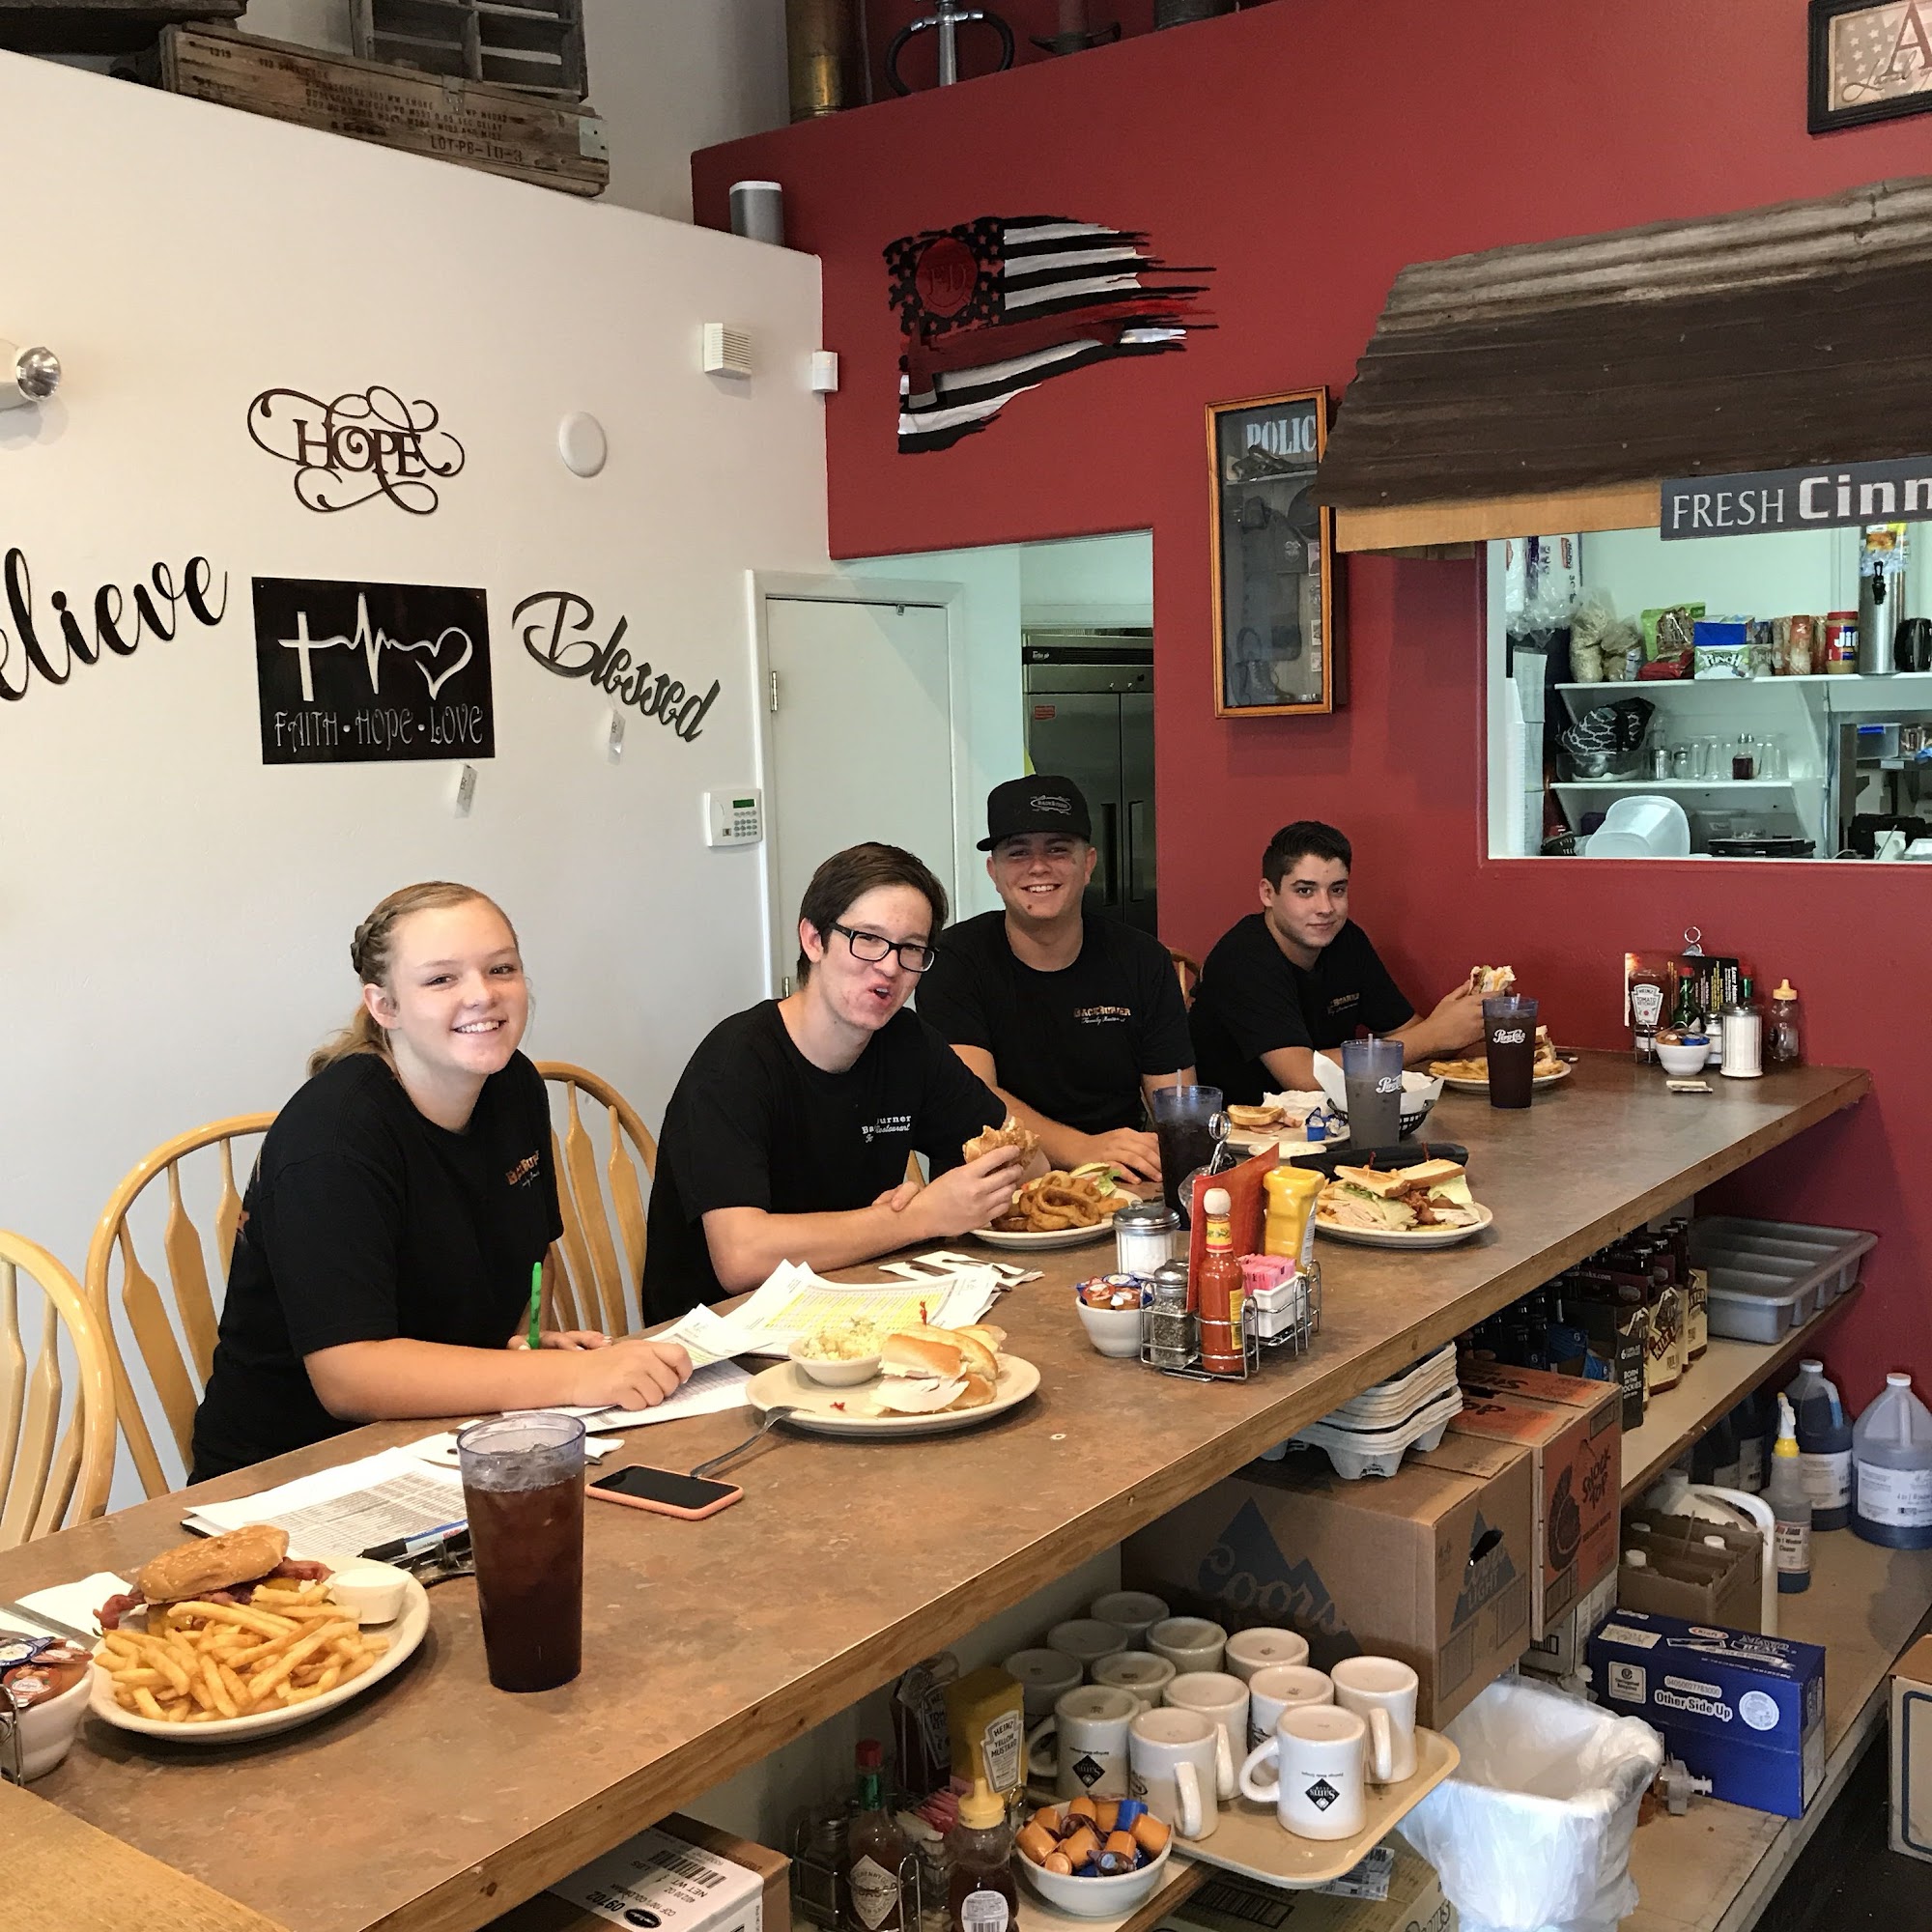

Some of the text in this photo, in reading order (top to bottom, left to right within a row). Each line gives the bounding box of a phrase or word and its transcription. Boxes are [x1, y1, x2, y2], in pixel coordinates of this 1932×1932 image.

[405, 96, 434, 110] SMOKE
[476, 120, 503, 132] DELAY
[1246, 414, 1316, 456] POLIC
[1672, 488, 1784, 529] FRESH
[512, 590, 721, 742] Blessed
[274, 705, 484, 753] FAITH HOPE LOVE
[1621, 1380, 1642, 1393] OCKIES
[1197, 1542, 1350, 1635] Coors
[1656, 1691, 1686, 1708] Other
[1689, 1698, 1713, 1714] Side
[1716, 1703, 1731, 1719] Up
[993, 1720, 1014, 1737] HEINZ
[990, 1738, 1018, 1758] MUSTARD
[994, 1732, 1014, 1748] YELLOW
[629, 1860, 651, 1870] LBS
[584, 1890, 626, 1913] 09702
[693, 1887, 708, 1898] NET
